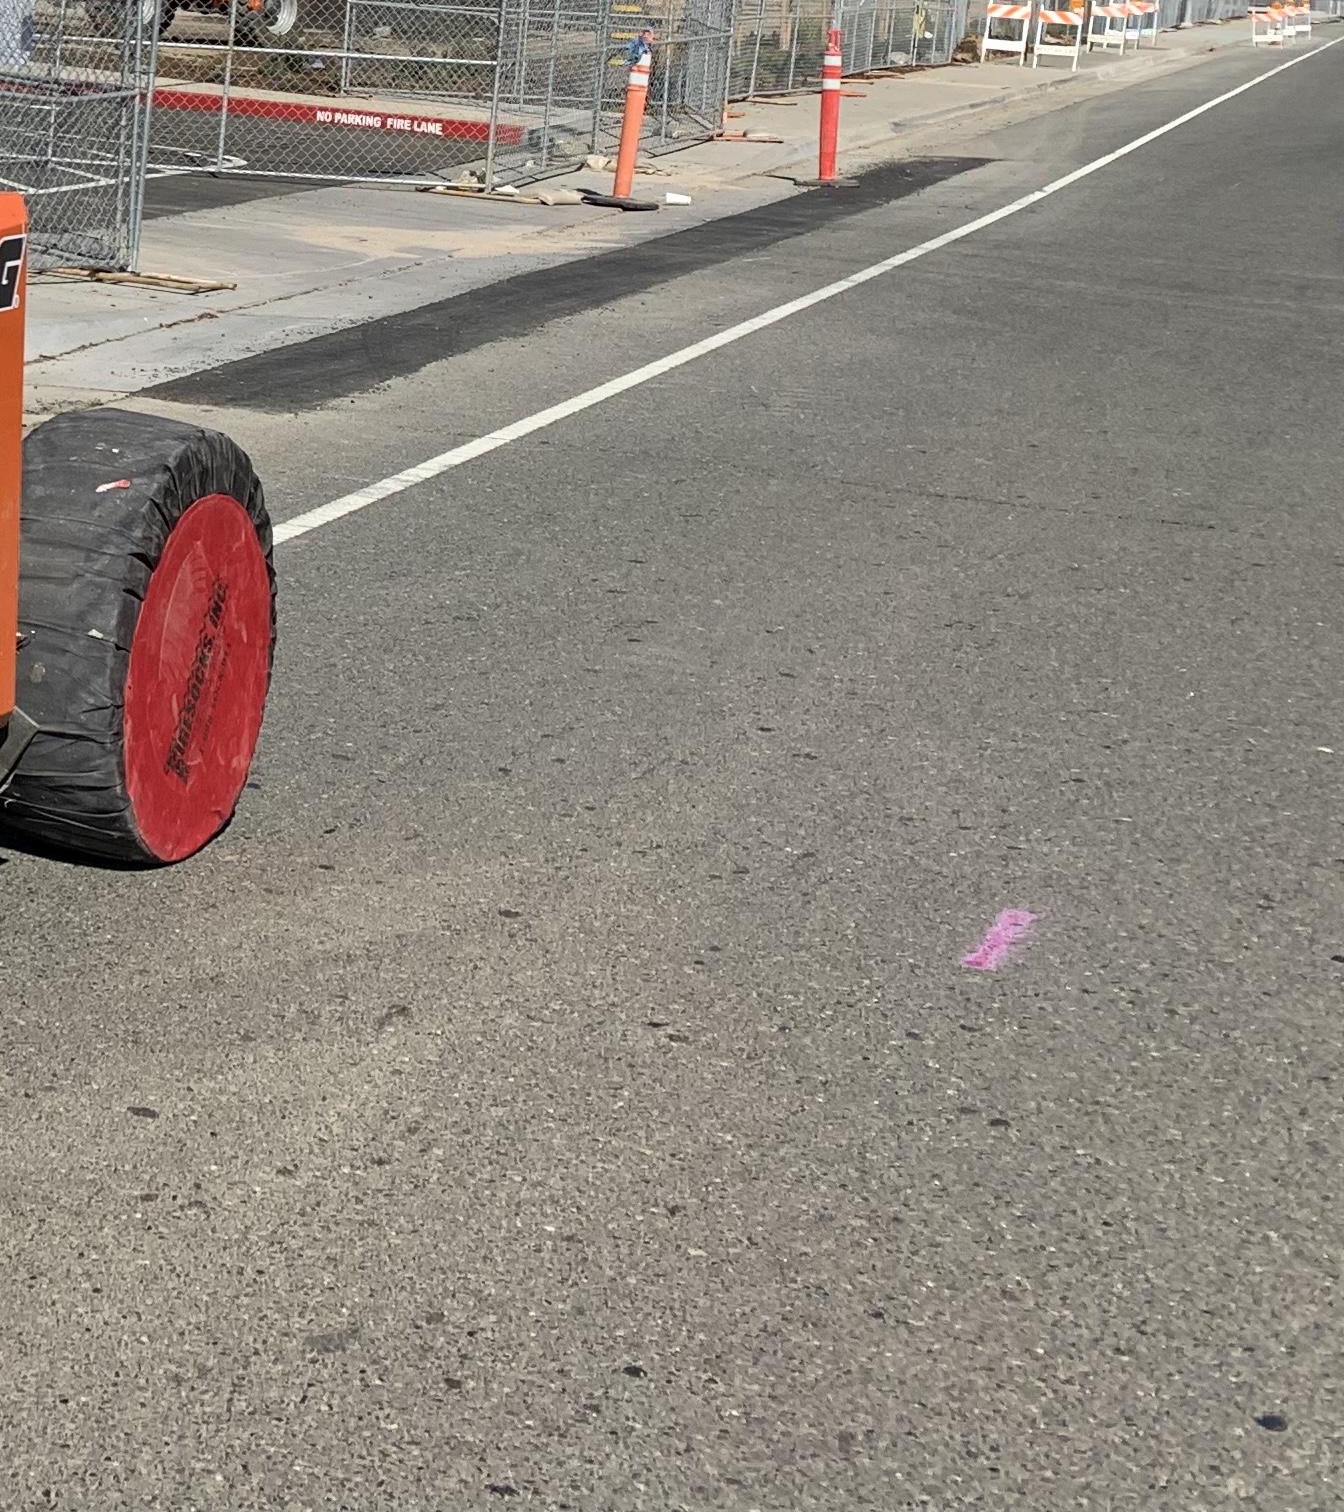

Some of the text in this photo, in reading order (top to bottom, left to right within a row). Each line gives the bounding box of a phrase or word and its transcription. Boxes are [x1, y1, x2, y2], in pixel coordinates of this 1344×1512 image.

[317, 110, 443, 136] NO PARKING FIRE LANE
